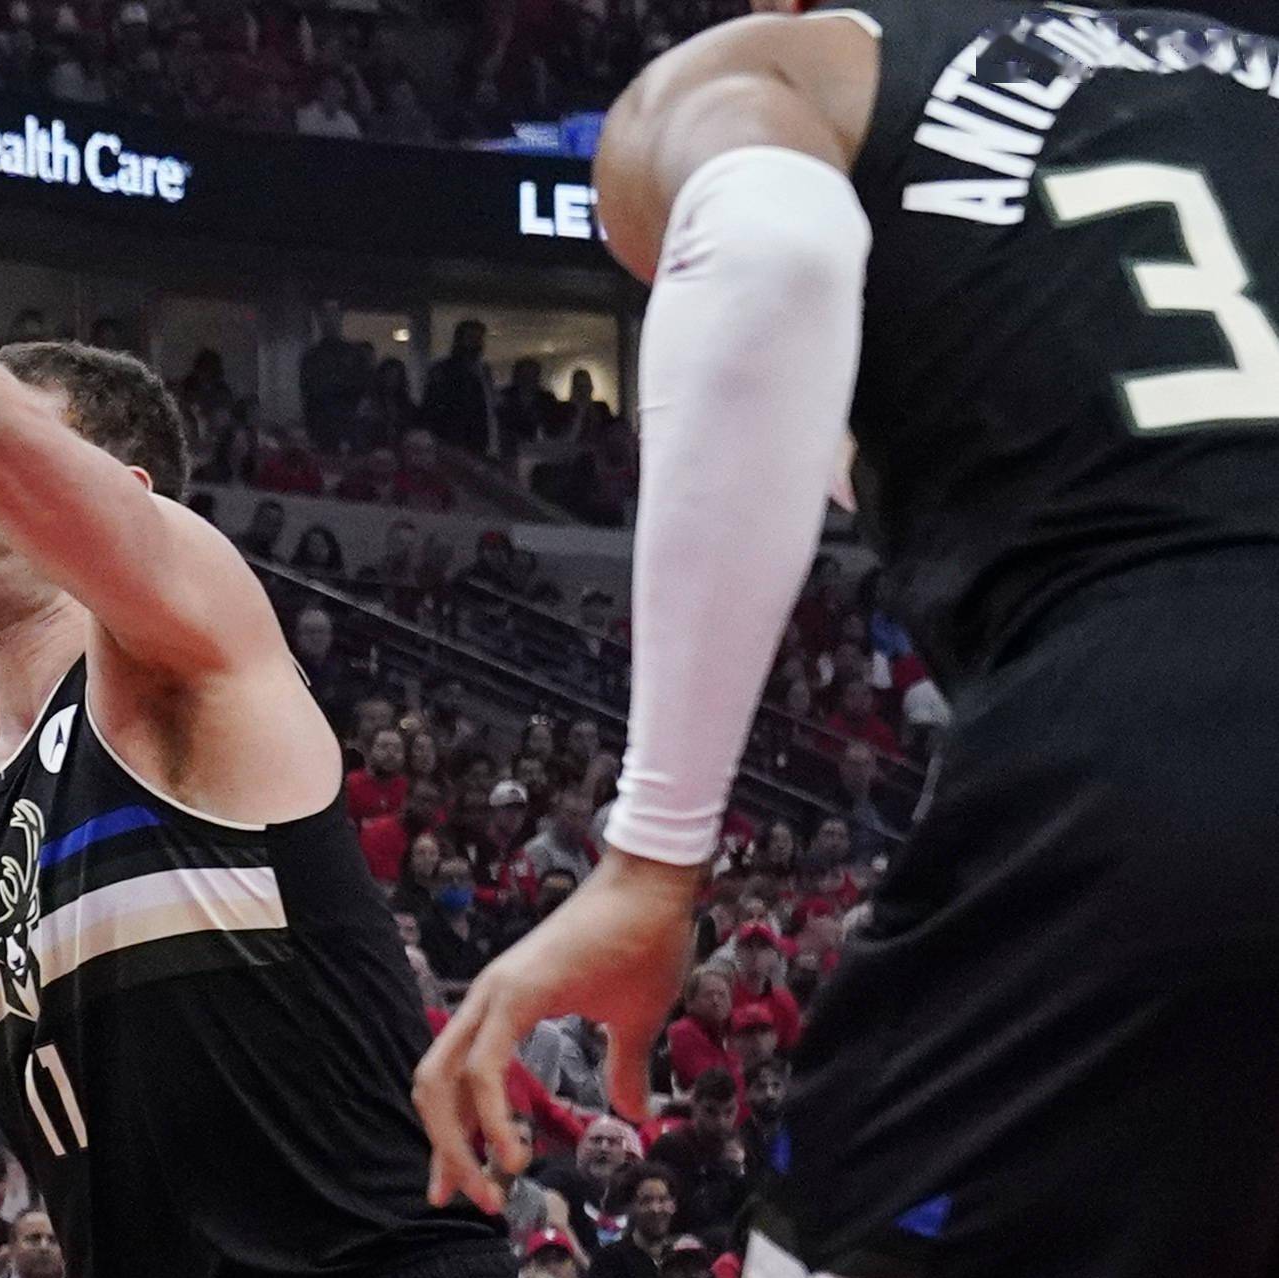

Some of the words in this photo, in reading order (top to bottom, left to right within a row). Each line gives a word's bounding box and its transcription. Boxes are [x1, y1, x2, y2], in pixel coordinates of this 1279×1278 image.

[84, 131, 186, 203] Care
[519, 181, 608, 240] LE
[24, 1044, 89, 1157] 11
